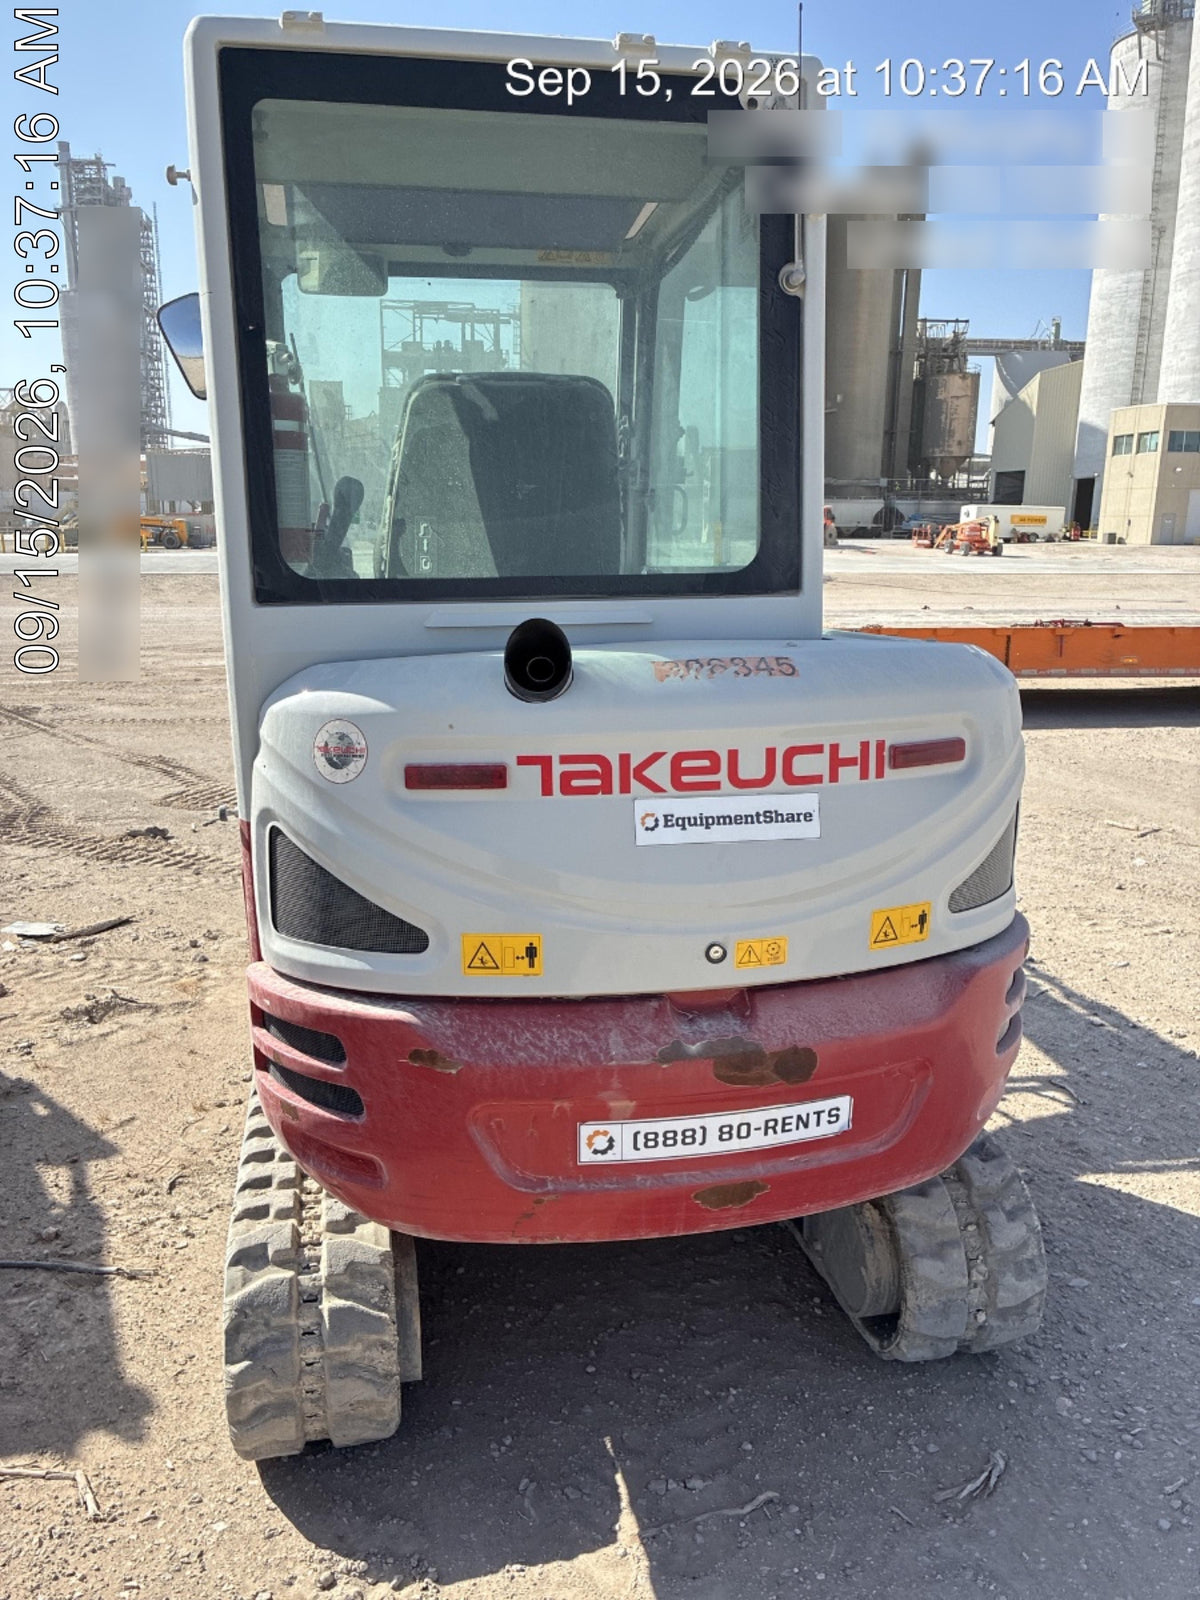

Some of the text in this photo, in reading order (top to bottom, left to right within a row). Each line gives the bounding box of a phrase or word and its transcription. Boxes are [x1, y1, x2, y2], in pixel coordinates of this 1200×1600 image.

[516, 740, 885, 796] TAKEUCHI
[662, 809, 814, 830] EquipmentShare
[633, 1107, 840, 1151] (888) 80-RENTS
